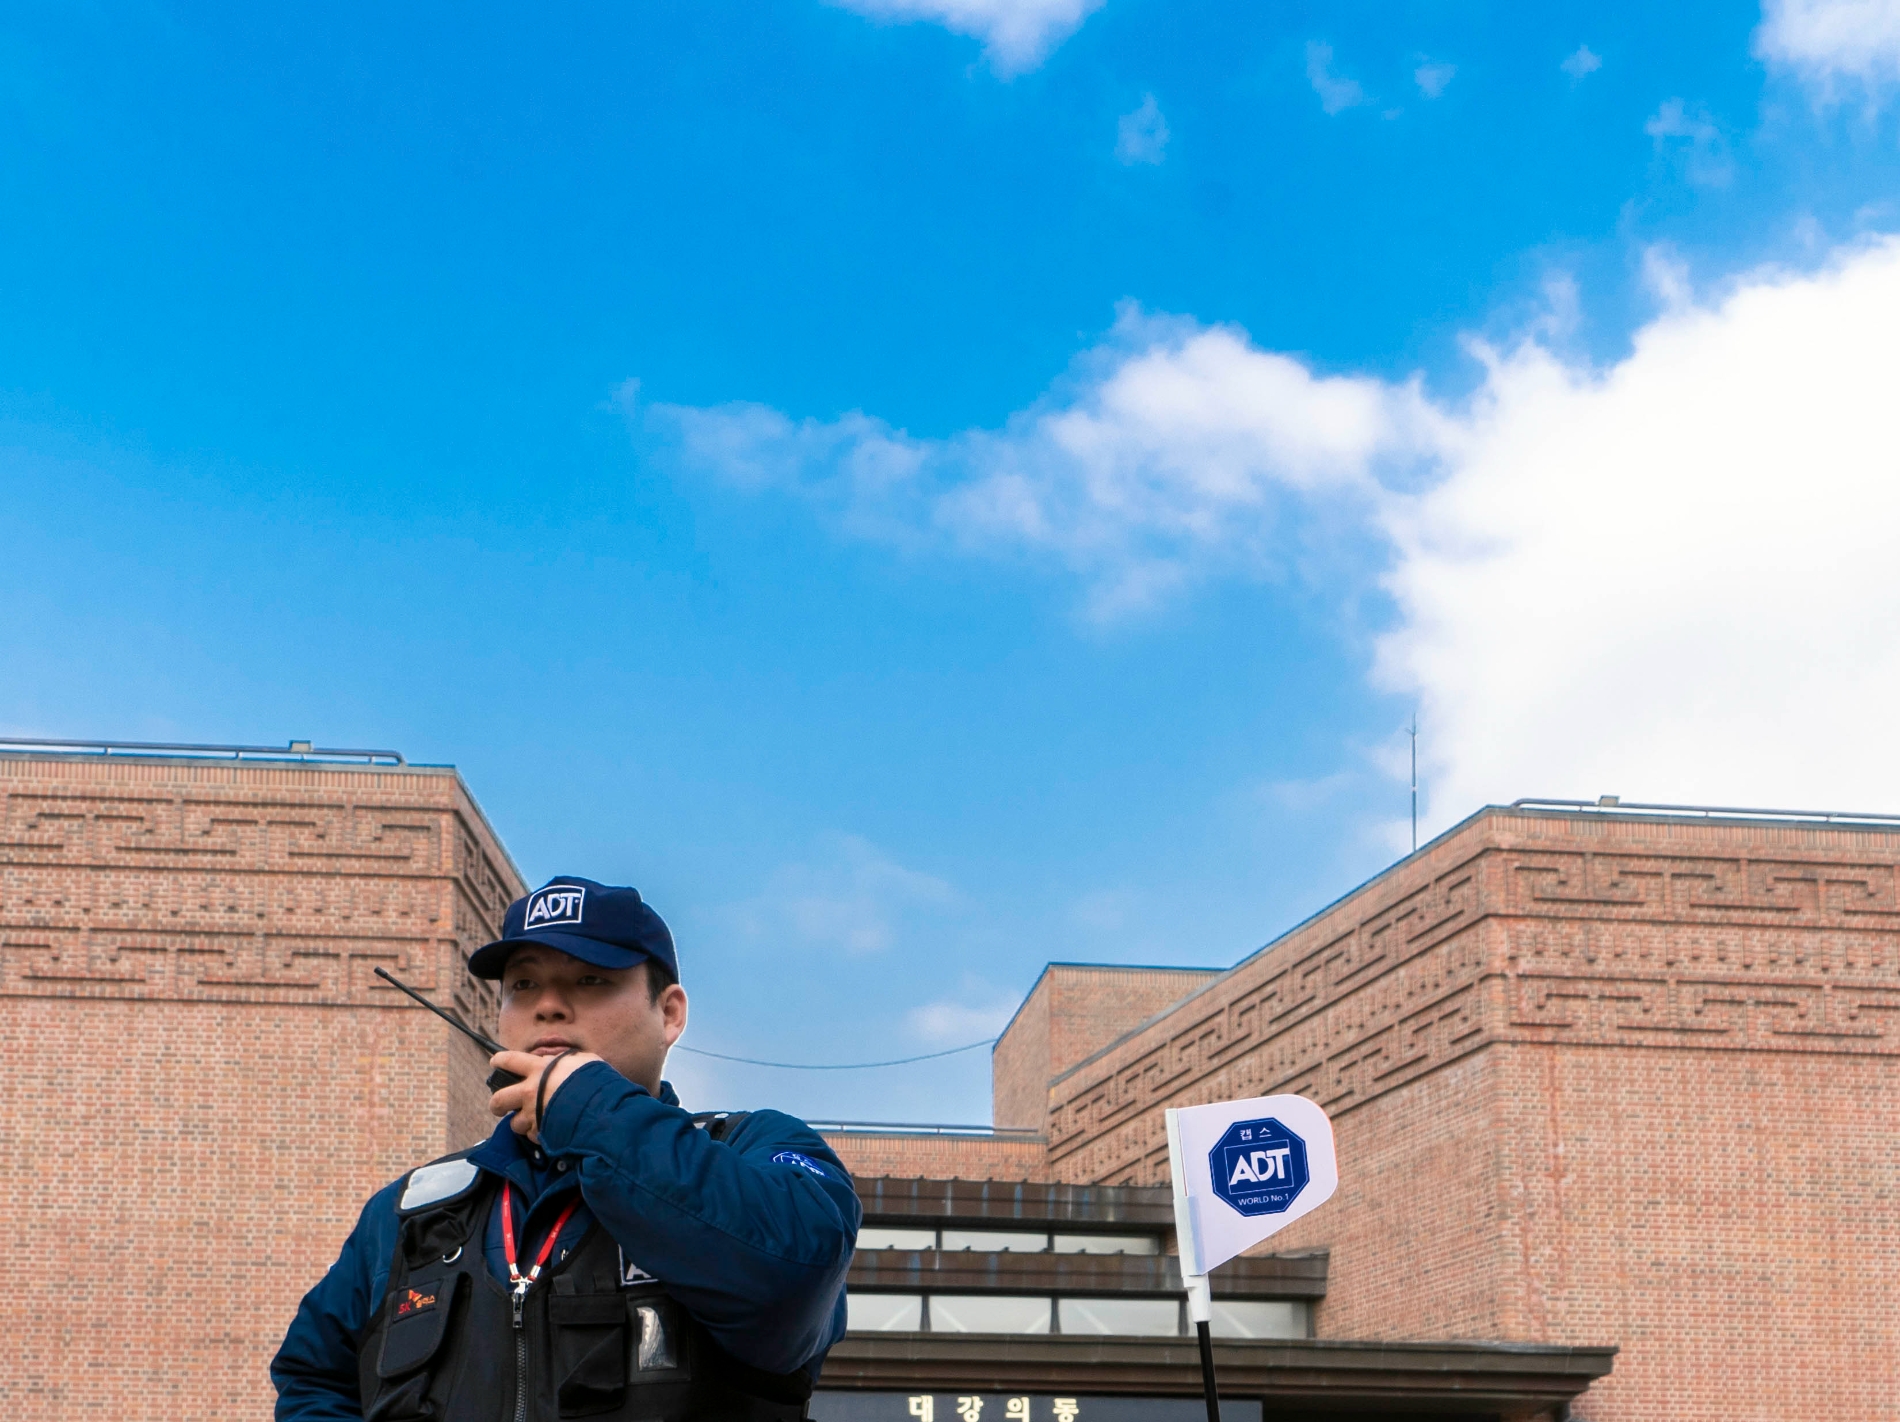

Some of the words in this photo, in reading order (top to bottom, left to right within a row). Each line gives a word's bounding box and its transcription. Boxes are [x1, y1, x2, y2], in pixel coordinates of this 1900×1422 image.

[529, 893, 581, 922] ADT
[1240, 1127, 1272, 1141] 캡스
[1229, 1148, 1290, 1186] ADT
[1238, 1195, 1269, 1206] WORLD
